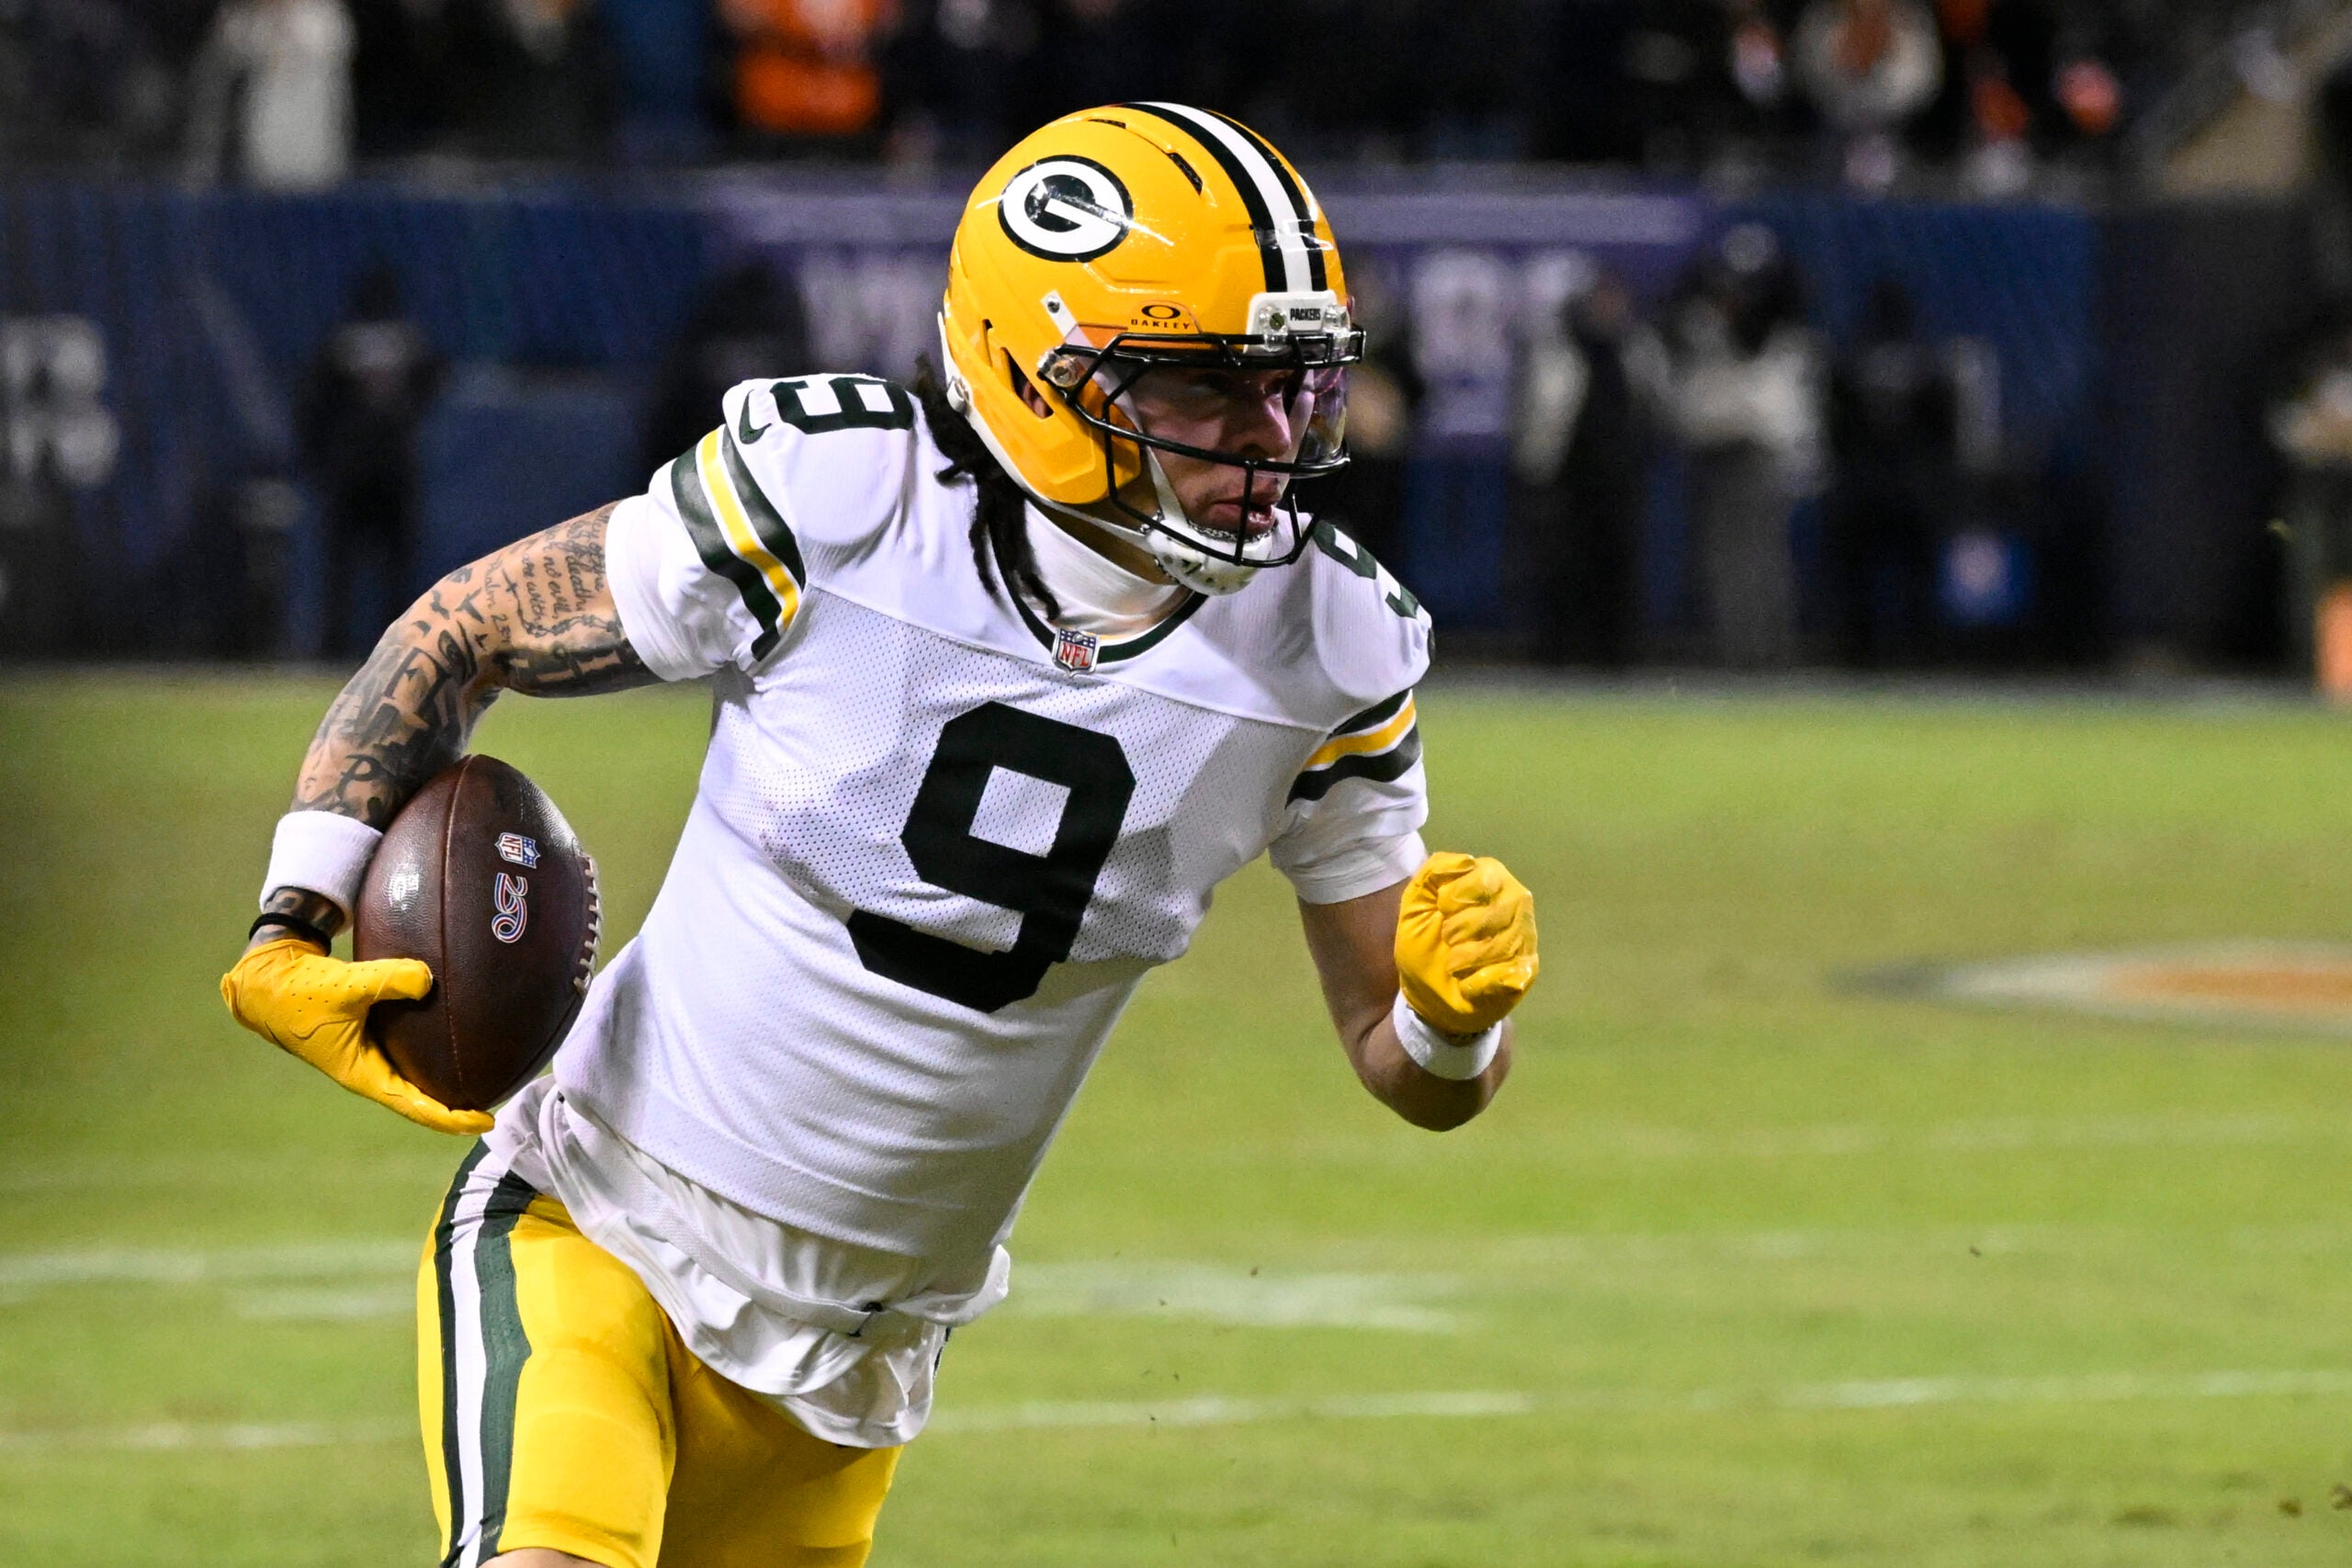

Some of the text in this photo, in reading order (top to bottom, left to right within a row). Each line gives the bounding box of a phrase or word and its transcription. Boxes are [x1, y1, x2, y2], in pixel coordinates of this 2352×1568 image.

[1130, 319, 1190, 330] OAKLEY
[1290, 308, 1321, 321] PACKERS
[770, 377, 914, 434] 9
[1059, 643, 1089, 667] NFL
[502, 836, 522, 858] NFL
[846, 700, 1136, 1013] 9
[492, 873, 528, 943] 250
